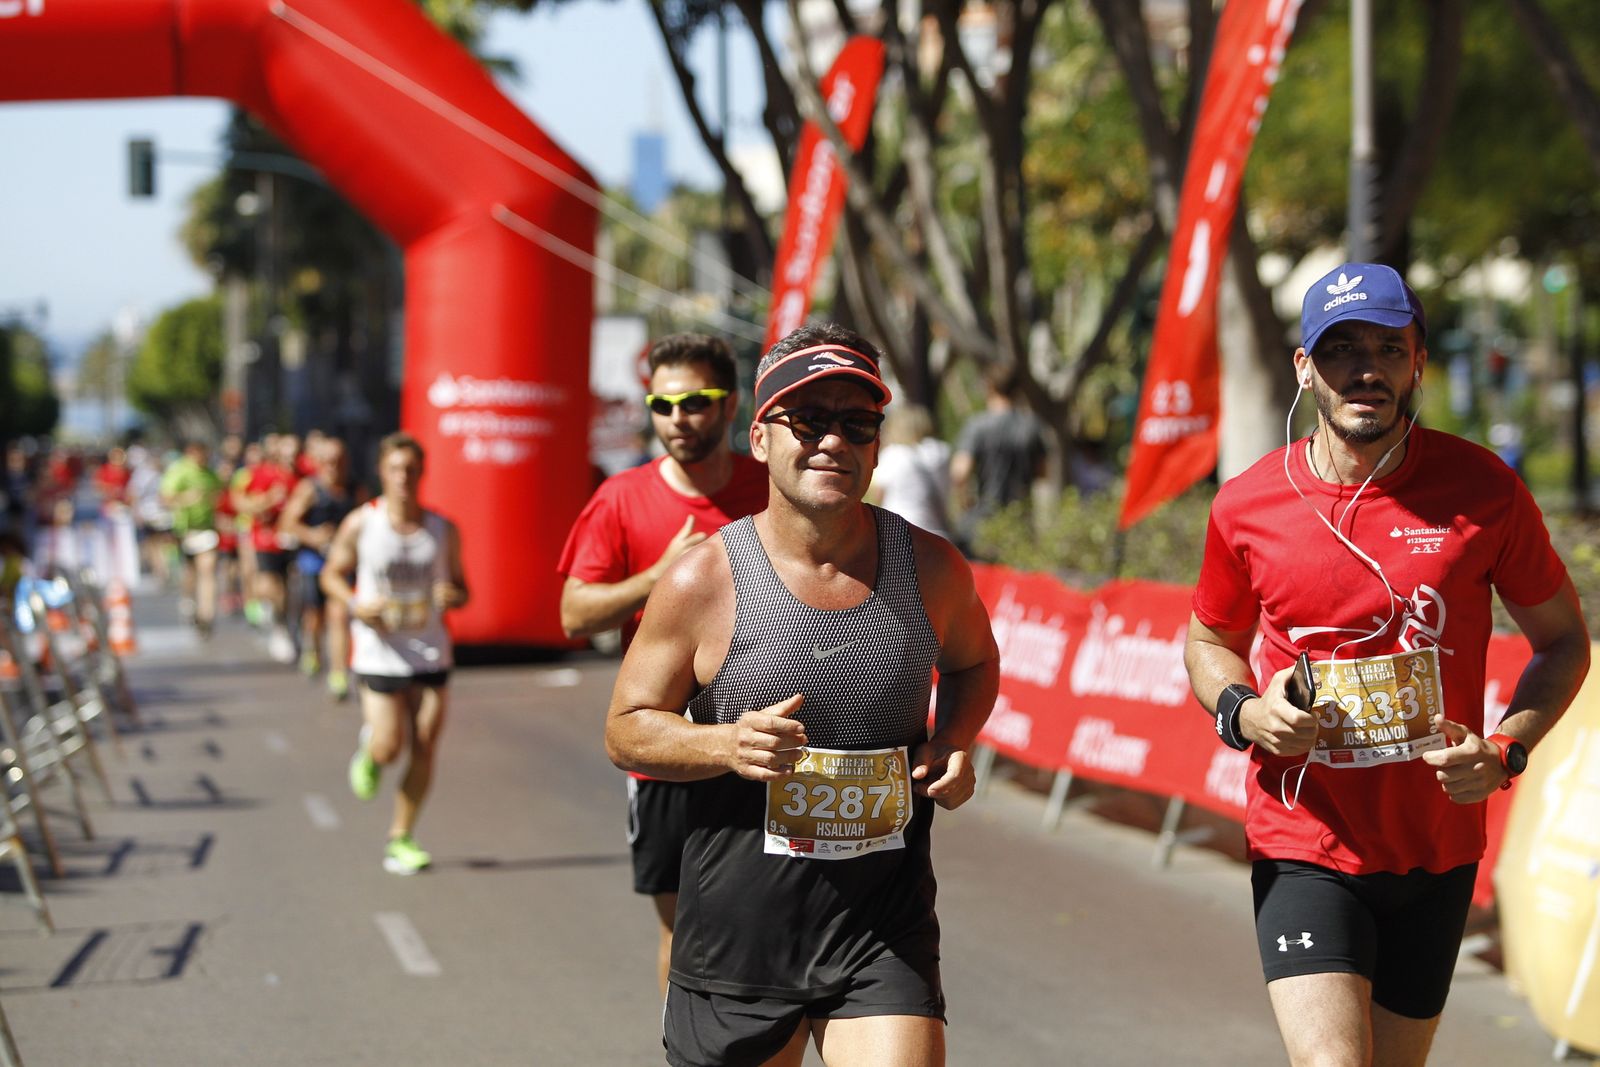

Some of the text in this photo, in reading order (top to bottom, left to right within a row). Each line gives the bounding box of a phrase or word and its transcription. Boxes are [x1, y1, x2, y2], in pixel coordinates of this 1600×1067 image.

[1323, 292, 1368, 312] adidas
[1403, 525, 1451, 536] Santander
[1314, 686, 1420, 729] 3233
[1343, 730, 1368, 745] JOSE
[823, 757, 874, 767] CARRERA
[782, 781, 892, 820] 3287
[816, 822, 866, 836] HSALVAH
